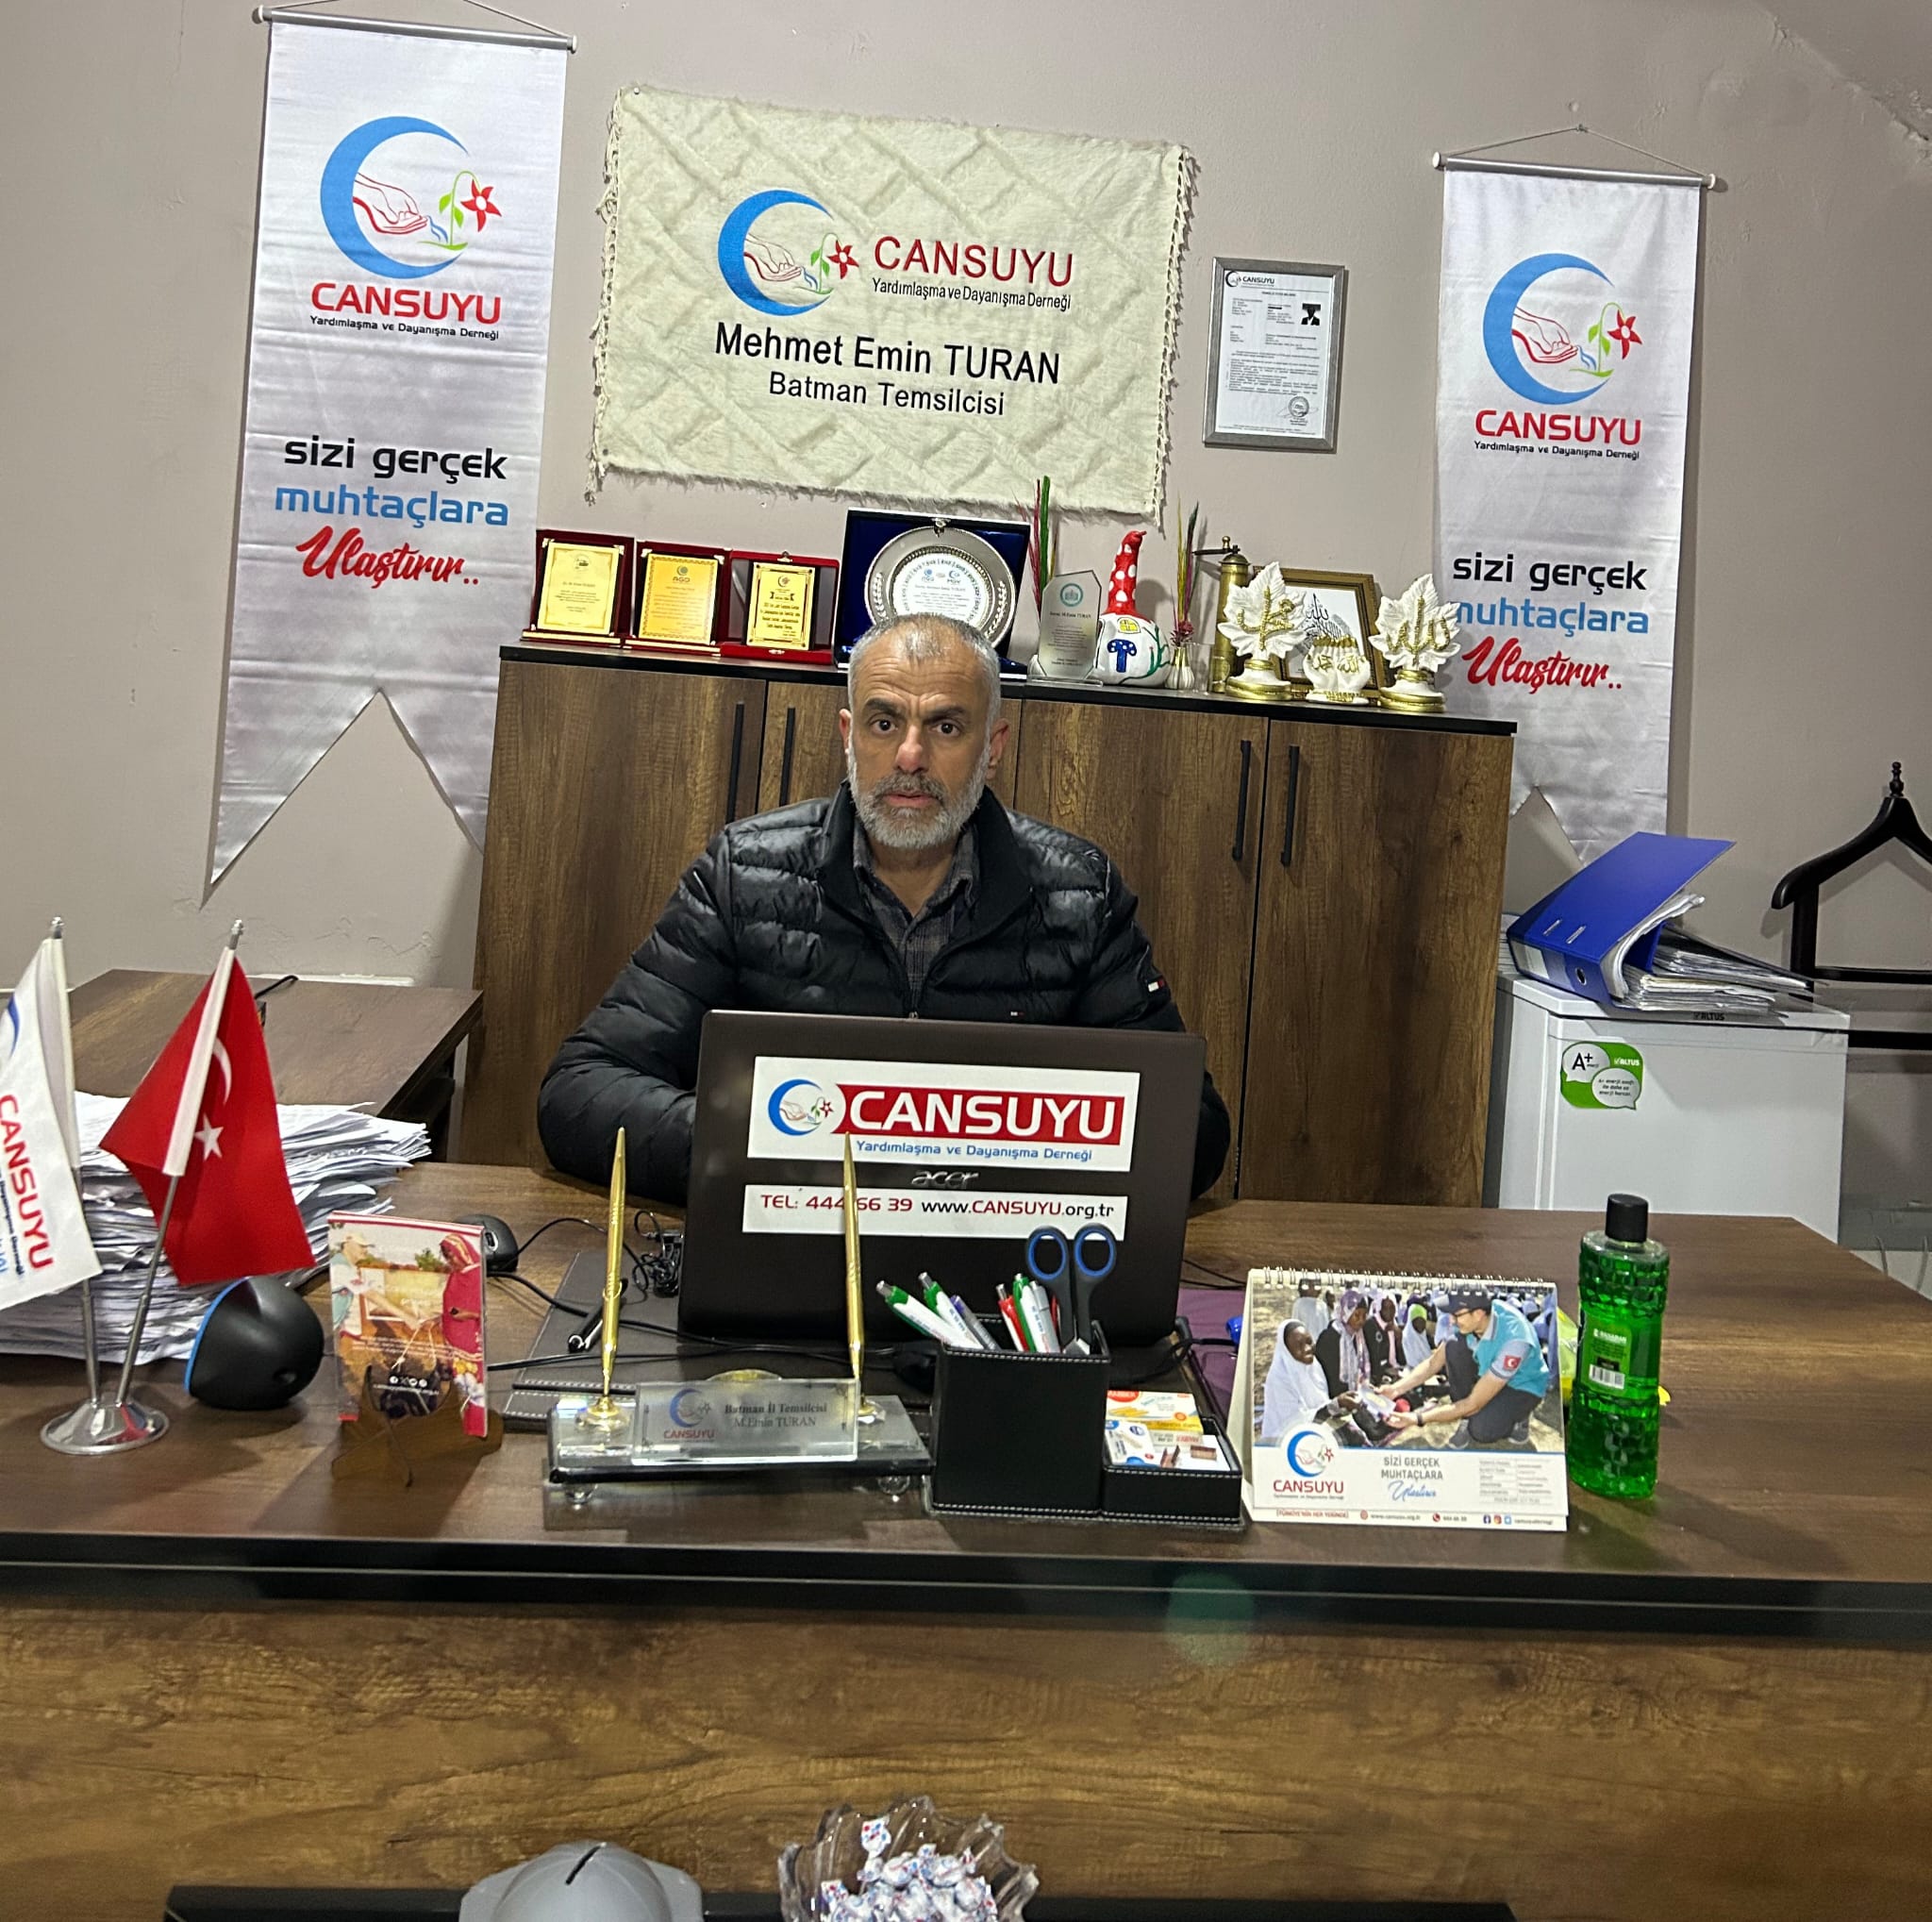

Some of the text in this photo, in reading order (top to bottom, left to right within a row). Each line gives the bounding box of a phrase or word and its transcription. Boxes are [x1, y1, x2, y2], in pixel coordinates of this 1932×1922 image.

[874, 235, 1074, 287] CANSUYU
[873, 277, 1072, 311] Yardımlaşma ve Dayanışma Derneği
[1242, 276, 1275, 285] CANSUYU
[311, 282, 502, 325] CANSUYU
[309, 315, 500, 342] Yardımlaşma ve Dayanışma Derneği
[715, 321, 1060, 385] Mehmet Emin TURAN
[769, 371, 1005, 416] Batman Temsilcisi
[1474, 409, 1642, 446] CANSUYU
[284, 434, 508, 485] sizi gerçek
[1474, 441, 1641, 461] Yardımlaşma ve Dayanışma Derneği
[275, 484, 509, 529] muhtaçlara
[1453, 552, 1648, 595] sizi gerçek
[1572, 1052, 1593, 1071] A+
[850, 1091, 1116, 1141] CANSUYU
[857, 1140, 1092, 1162] Yardımlaşma ve Dayanışma Derneği
[0, 1095, 54, 1270] CANSUYU
[911, 1170, 980, 1190] acer
[760, 1195, 799, 1210] TEL:
[888, 1198, 913, 1212] 39
[922, 1199, 1115, 1220] www.CANSUYU.org.tr
[663, 1429, 715, 1440] CANSUYU
[776, 1417, 817, 1428] TURAN
[1380, 1469, 1444, 1480] MUHTAÇLARA
[1383, 1454, 1441, 1470] SİZİ GERÇEK
[1273, 1479, 1344, 1495] CANSUYU
